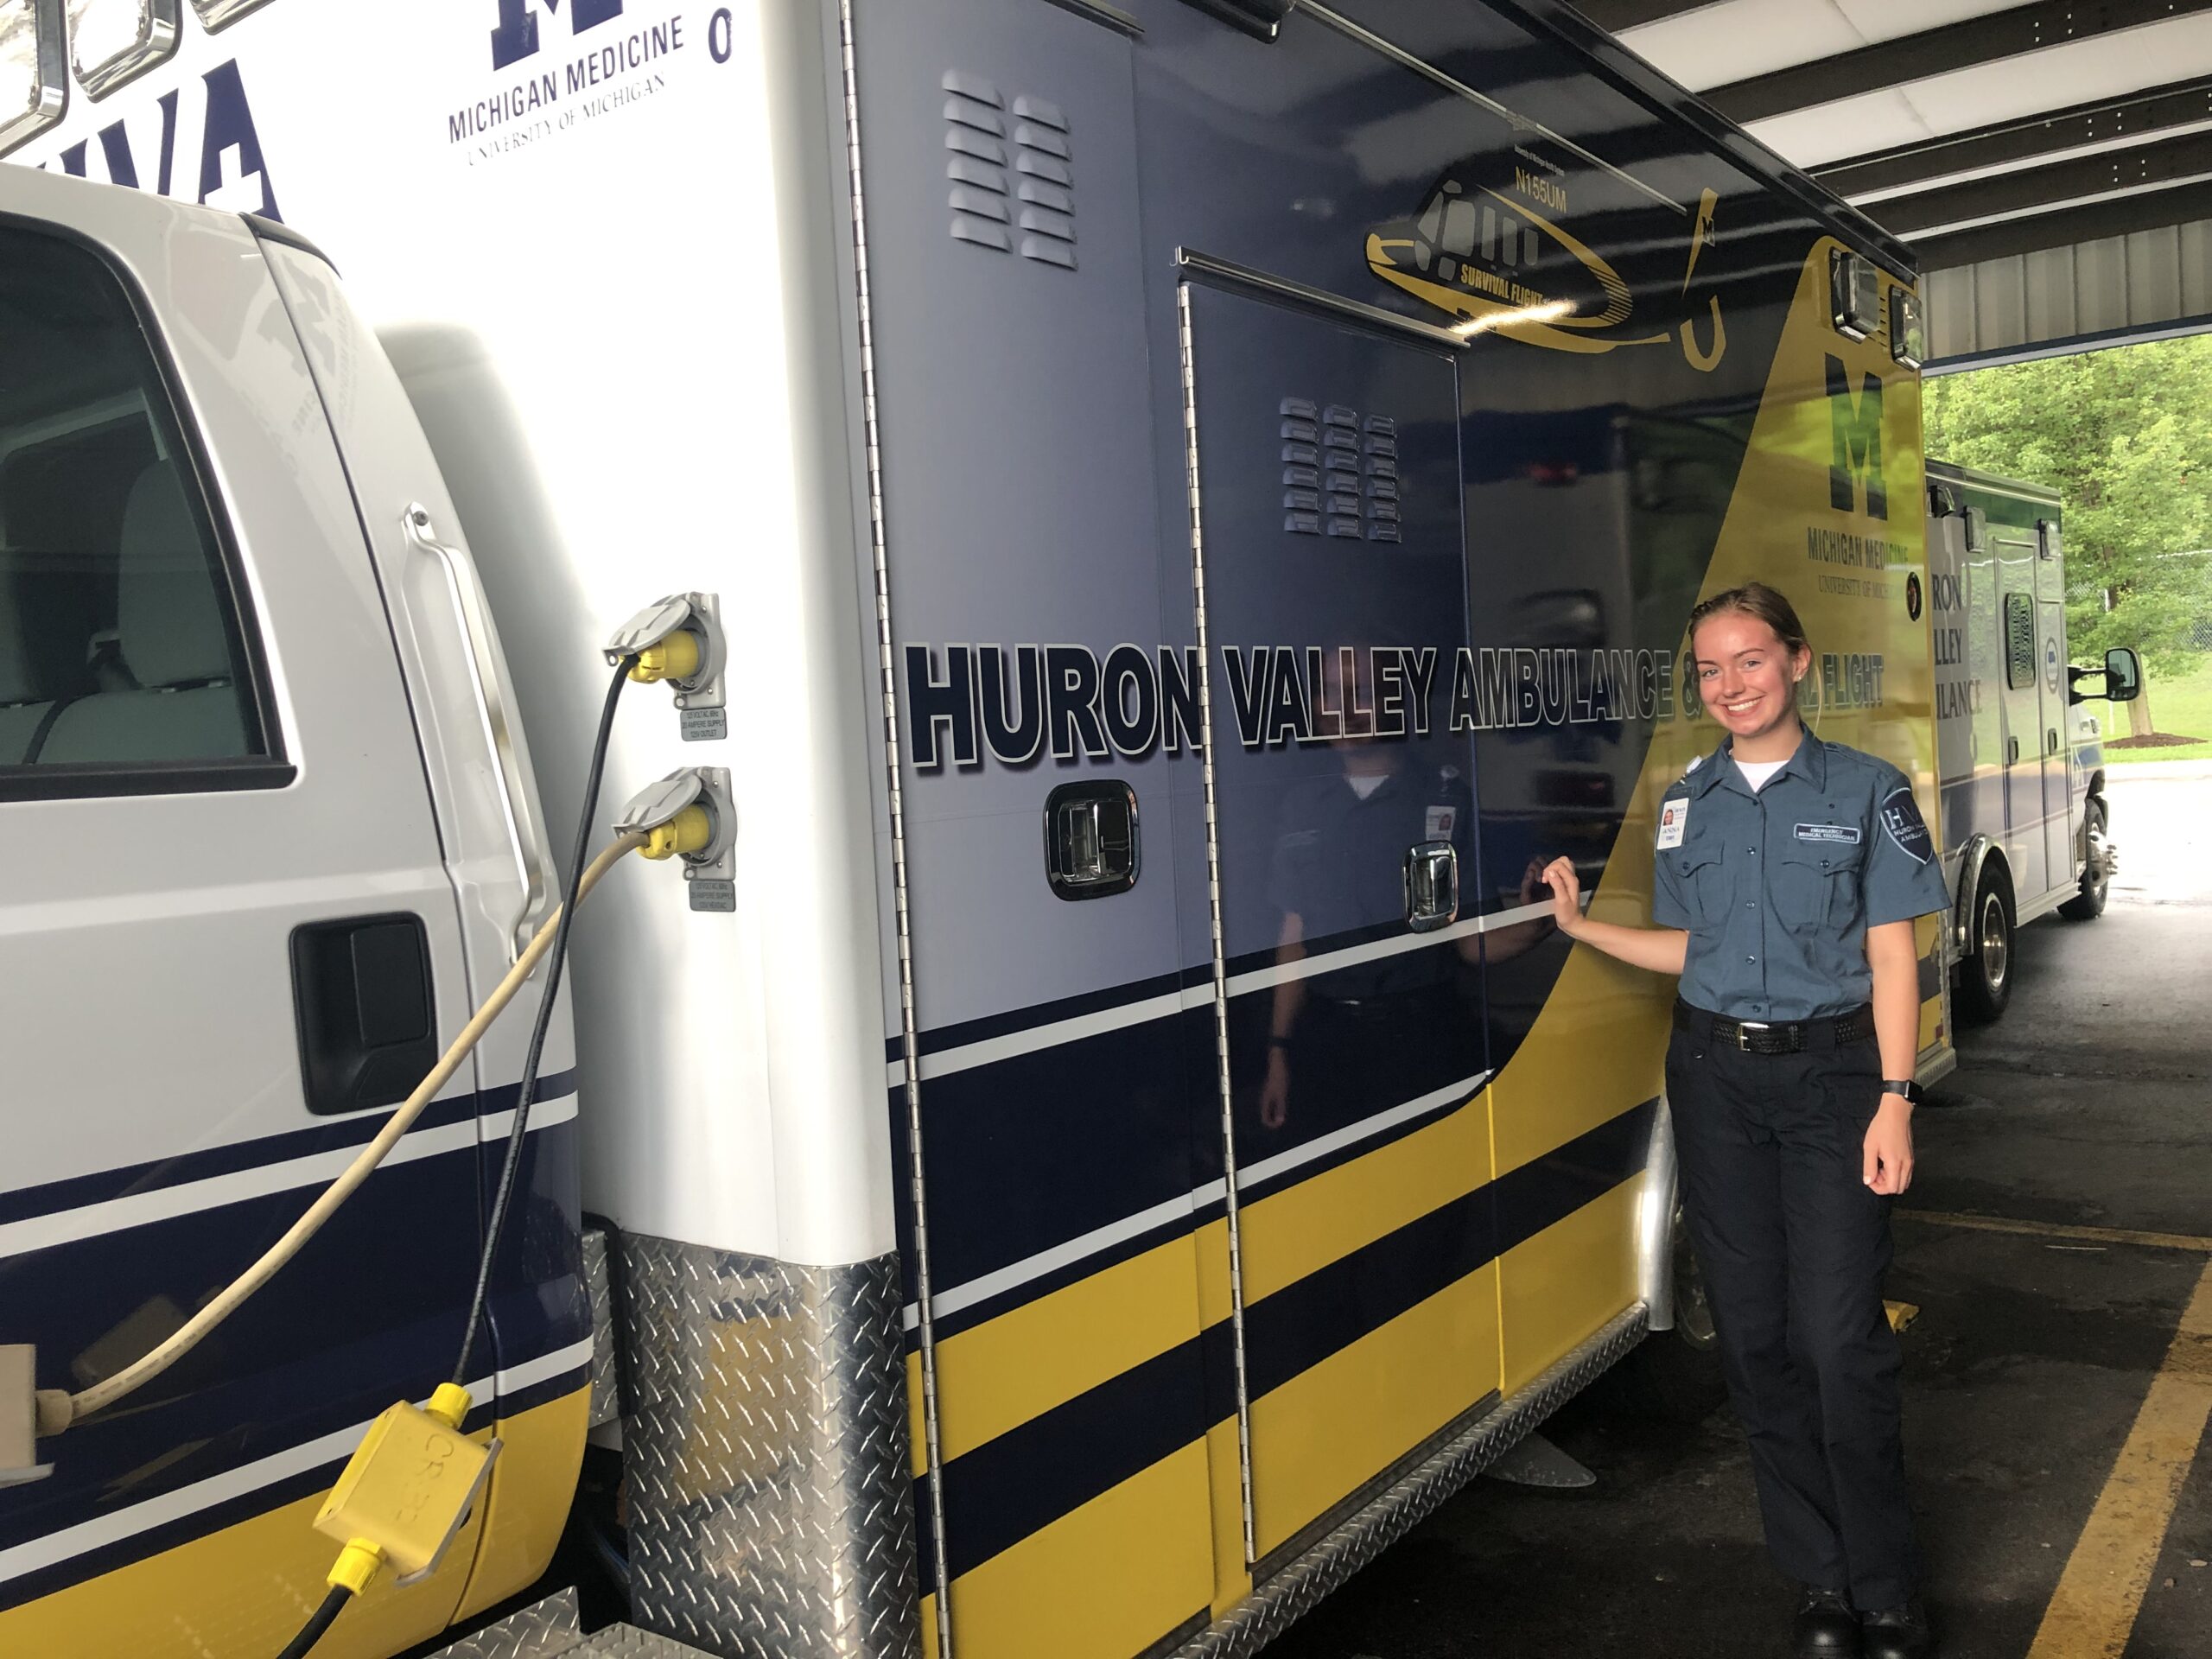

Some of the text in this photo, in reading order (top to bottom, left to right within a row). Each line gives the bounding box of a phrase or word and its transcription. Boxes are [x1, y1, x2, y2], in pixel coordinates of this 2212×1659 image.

[448, 71, 557, 143] MICHIGAN
[566, 15, 683, 95] MEDICINE
[36, 58, 284, 224] VA
[467, 72, 665, 166] UNIVERSITY OF MICHIGAN
[1516, 166, 1567, 214] N155UM
[1461, 264, 1543, 306] SURVIVAL FLIGHT
[1825, 353, 1887, 521] M
[1808, 526, 1909, 571] MICHIGAN MEDICINE
[1818, 575, 1861, 597] UNIVERSITY
[1863, 581, 1871, 598] OF
[903, 642, 1203, 767] HURON
[1221, 645, 1437, 746] VALLEY
[1449, 648, 1675, 731] AMBULANCE
[1822, 652, 1885, 711] FLIGHT
